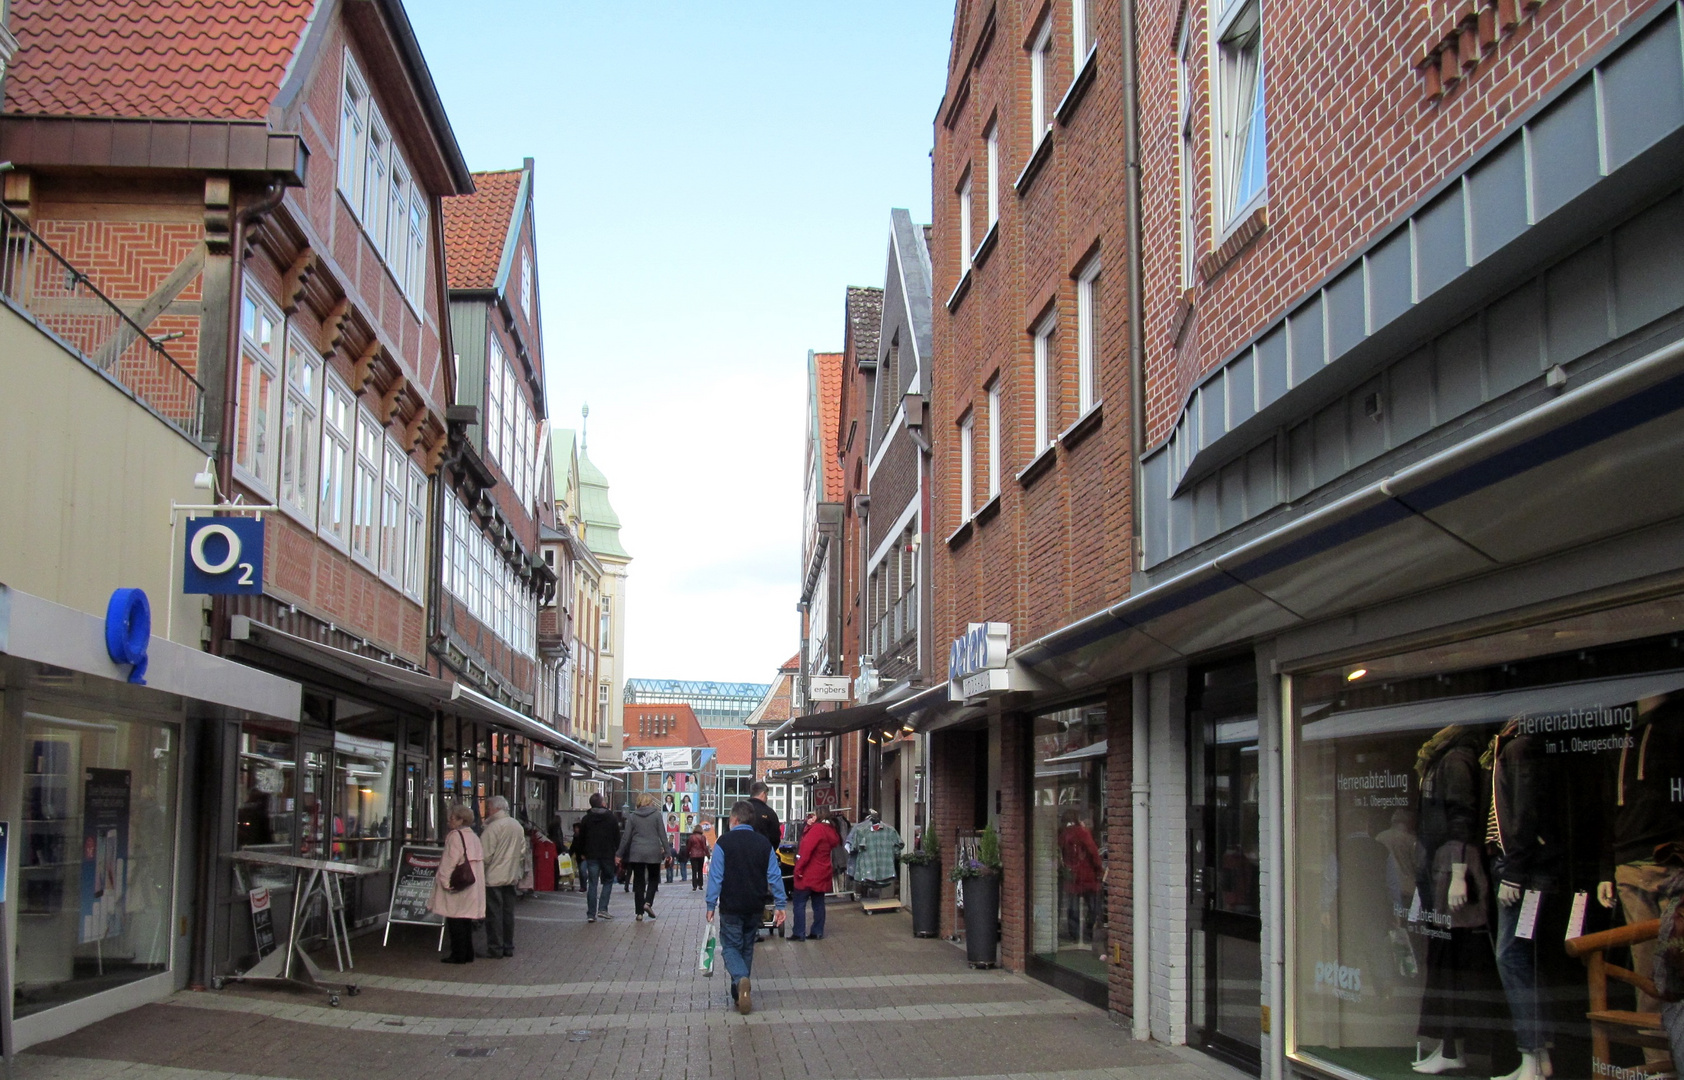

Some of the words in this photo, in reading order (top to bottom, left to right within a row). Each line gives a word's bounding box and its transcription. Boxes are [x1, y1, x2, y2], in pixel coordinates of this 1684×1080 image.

[190, 524, 254, 585] O2
[813, 686, 846, 695] engbers
[1517, 703, 1634, 735] Herrenabteilung
[1545, 739, 1557, 753] im
[1560, 739, 1569, 752] 1.
[1571, 734, 1634, 754] Obergeschoss
[1337, 769, 1409, 793] Herrenabteilung
[1670, 777, 1684, 803] H
[1354, 795, 1362, 807] im
[1370, 795, 1409, 809] Obergeschoss
[1420, 926, 1452, 940] Obergeschoss
[1315, 960, 1361, 992] peters
